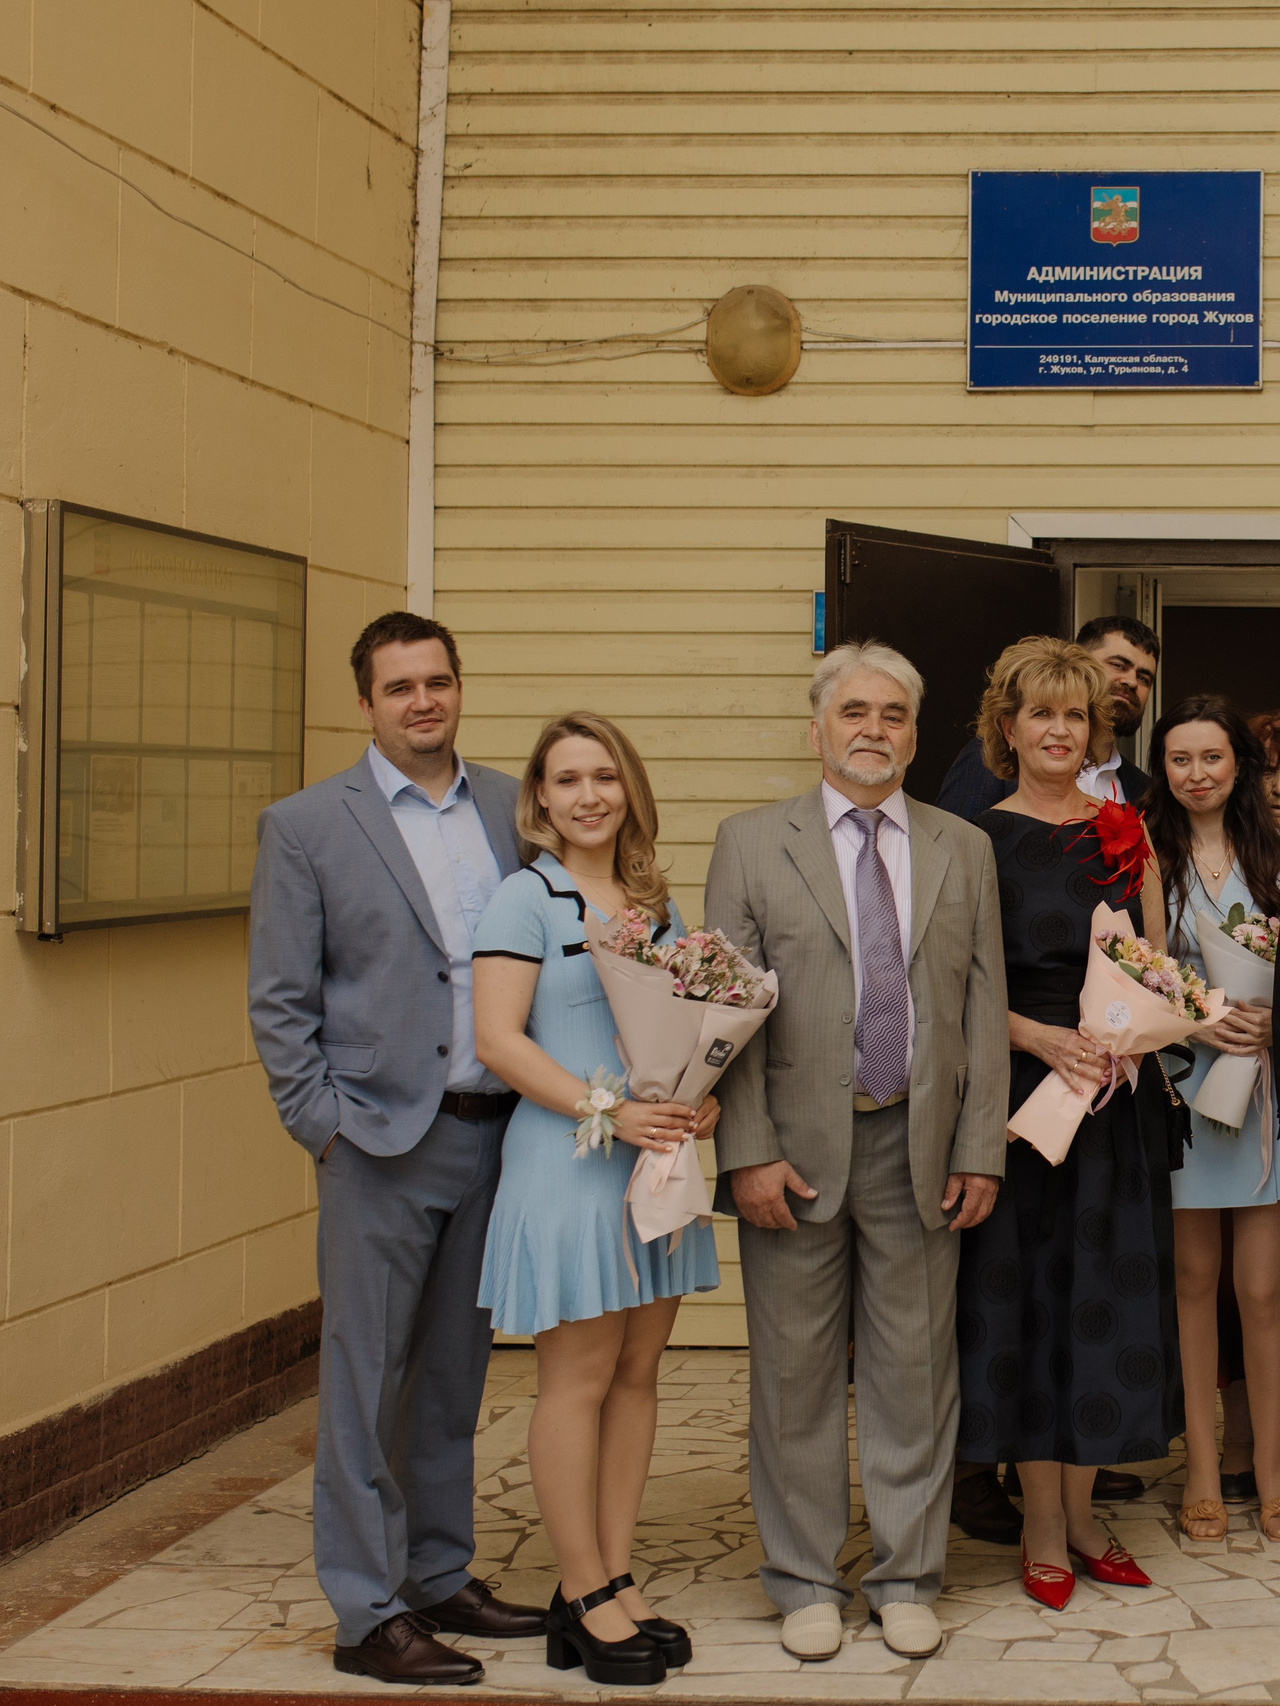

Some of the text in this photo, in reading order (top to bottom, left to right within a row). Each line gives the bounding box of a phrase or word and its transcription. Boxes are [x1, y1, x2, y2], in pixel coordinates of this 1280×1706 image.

[1027, 266, 1202, 283] АДМИНИСТРАЦИЯ
[994, 289, 1235, 305] Муниципального образования
[975, 311, 1254, 325] городское поселение город Жуков
[1039, 353, 1188, 364] 249191, Калужская область,
[1050, 365, 1087, 375] Жуков,
[1089, 367, 1105, 375] ул.
[1108, 365, 1165, 375] Гурьянова,
[1167, 367, 1179, 375] д.
[1181, 365, 1189, 373] 4
